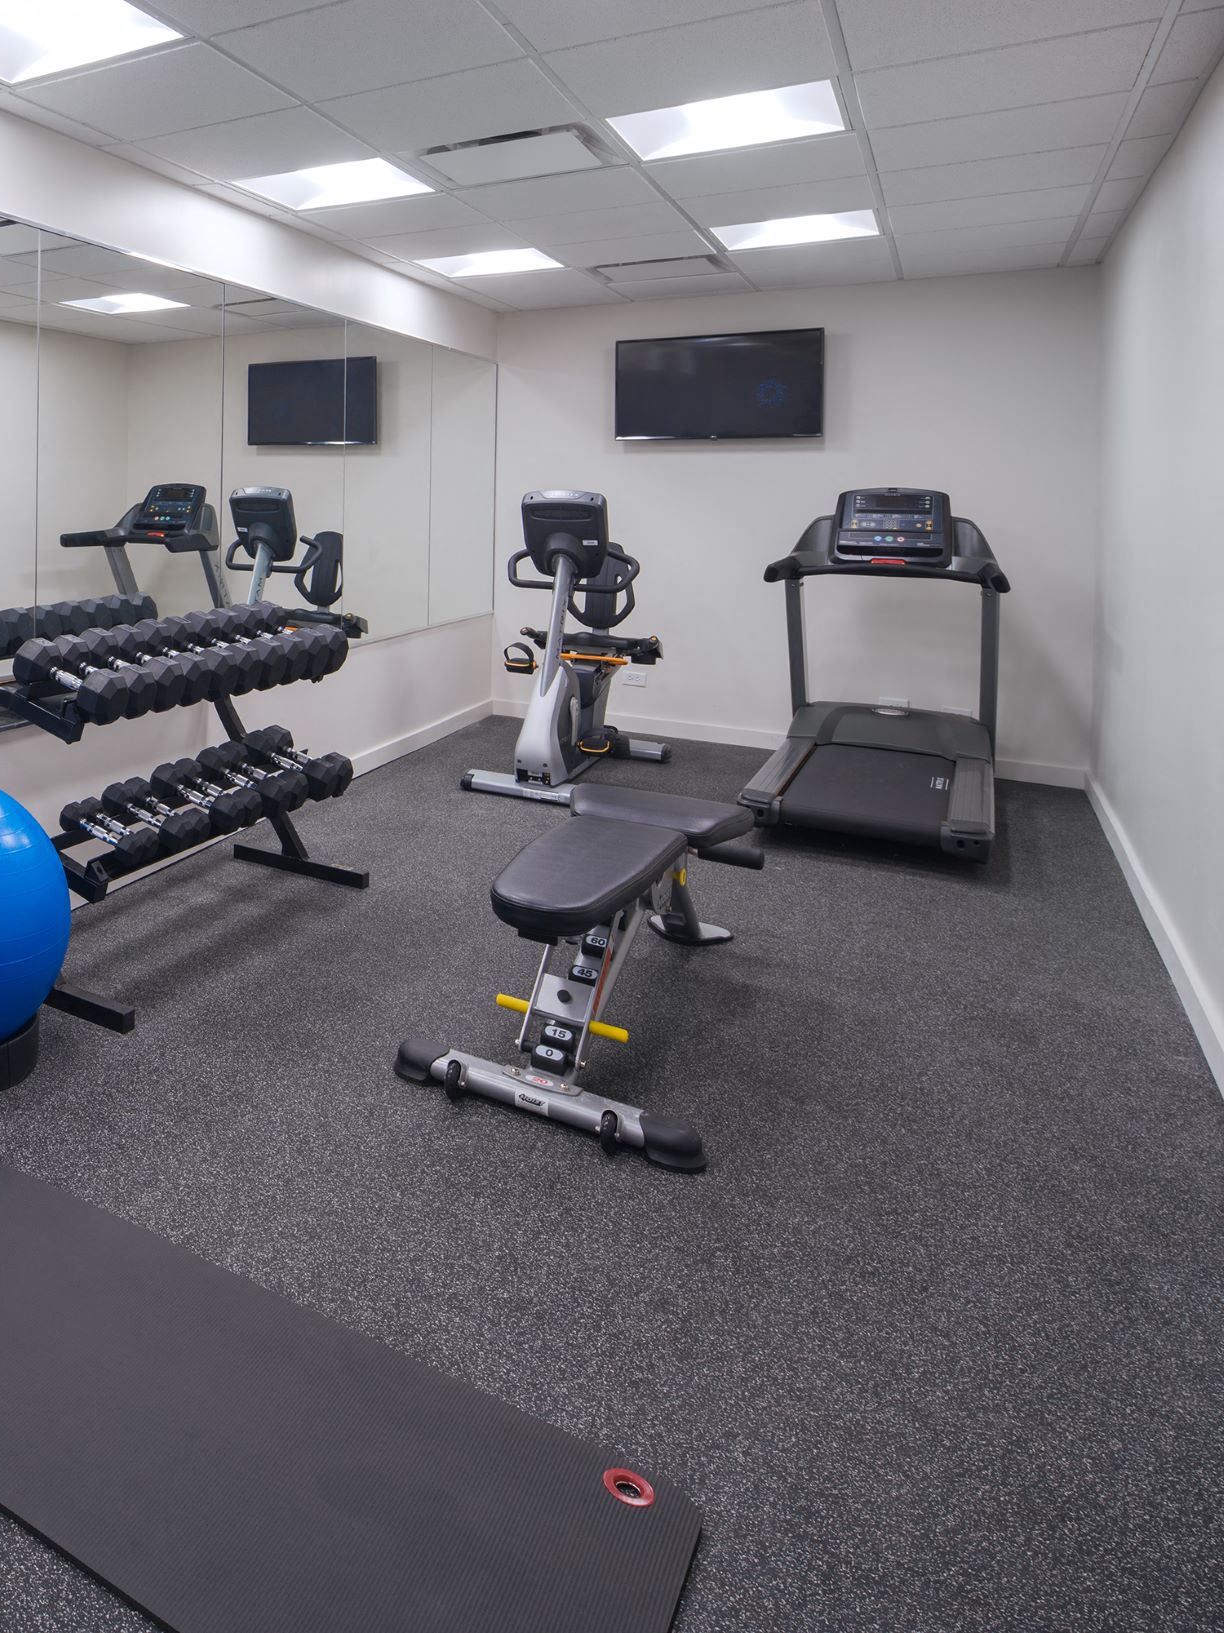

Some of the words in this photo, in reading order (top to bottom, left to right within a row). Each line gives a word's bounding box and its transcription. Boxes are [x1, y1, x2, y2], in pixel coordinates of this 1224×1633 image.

[591, 937, 605, 946] 60
[578, 968, 593, 977] 45
[552, 1028, 566, 1039] 15
[545, 1048, 554, 1058] 0
